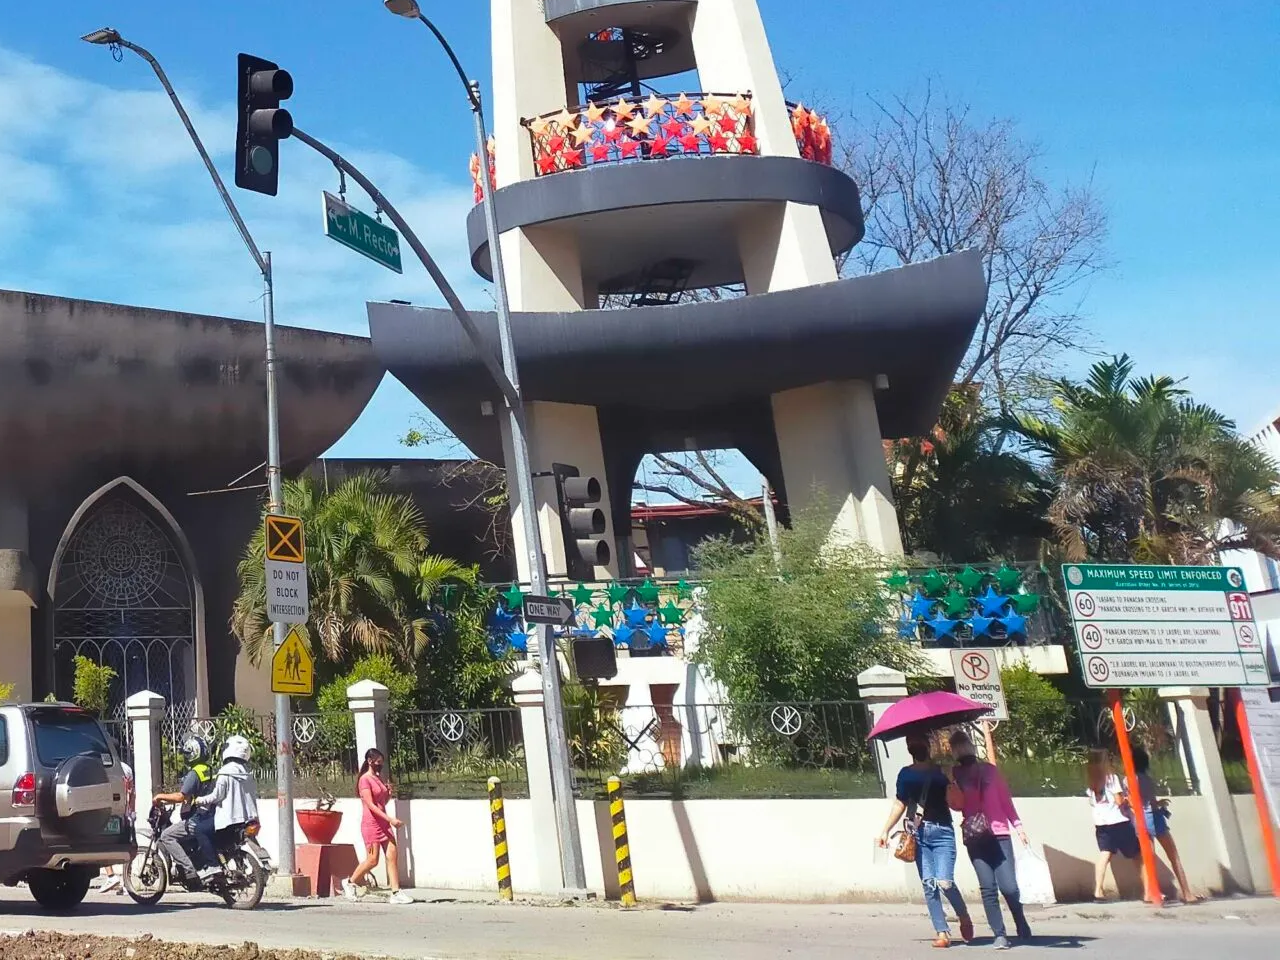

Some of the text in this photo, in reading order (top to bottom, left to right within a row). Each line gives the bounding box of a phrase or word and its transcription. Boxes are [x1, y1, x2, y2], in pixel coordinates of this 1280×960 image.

[363, 224, 394, 257] Recto
[273, 570, 300, 581] DO NOT
[1087, 569, 1222, 580] MAXIMUM SPEED LIMIT ENFORCED
[276, 588, 299, 599] BLOCK
[271, 604, 305, 616] INTERSECTION
[529, 604, 561, 616] ONE WAY
[1079, 599, 1092, 610] 60
[1230, 601, 1252, 619] 911
[1086, 631, 1099, 642] 40
[1092, 663, 1106, 675] 30
[959, 683, 1000, 692] No Parking
[970, 692, 993, 701] along
